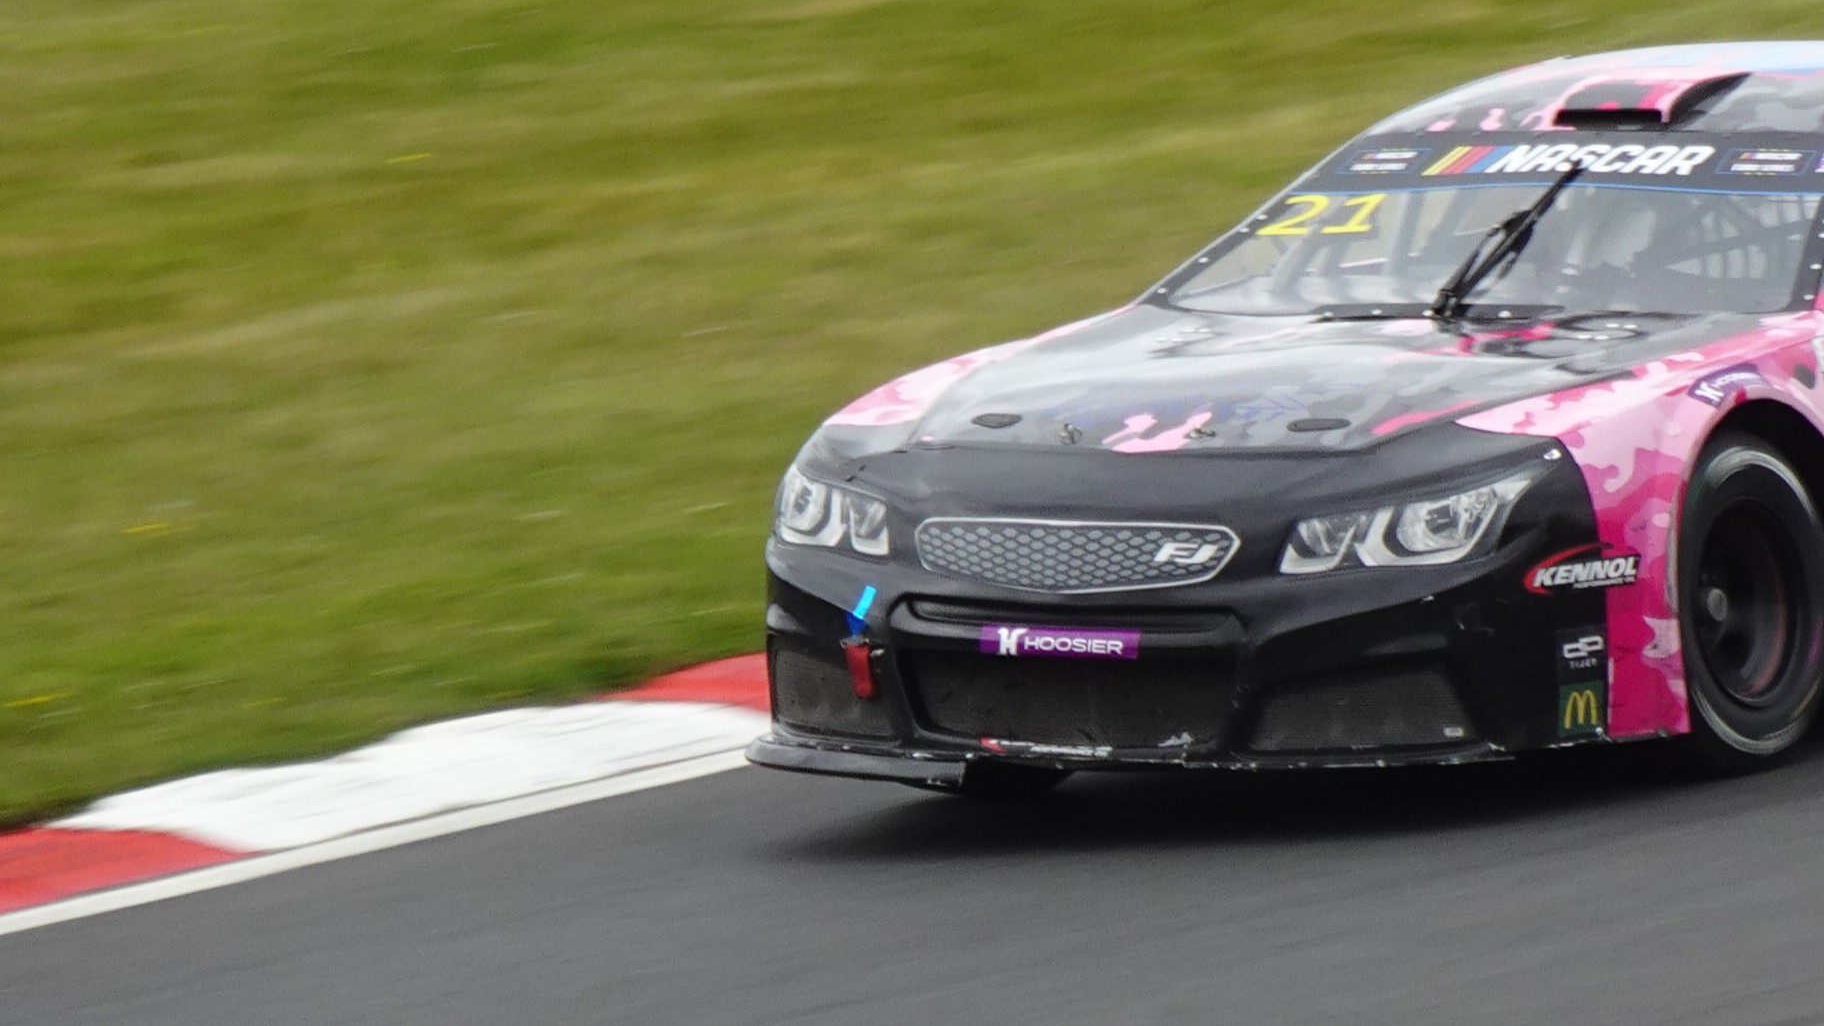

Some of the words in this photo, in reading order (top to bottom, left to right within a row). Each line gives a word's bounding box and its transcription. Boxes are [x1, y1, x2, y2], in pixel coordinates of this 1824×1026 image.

[1484, 143, 1717, 176] NASCAR
[1254, 192, 1389, 237] 21
[1532, 556, 1638, 588] KENNOL
[1022, 636, 1124, 655] HOOSIER
